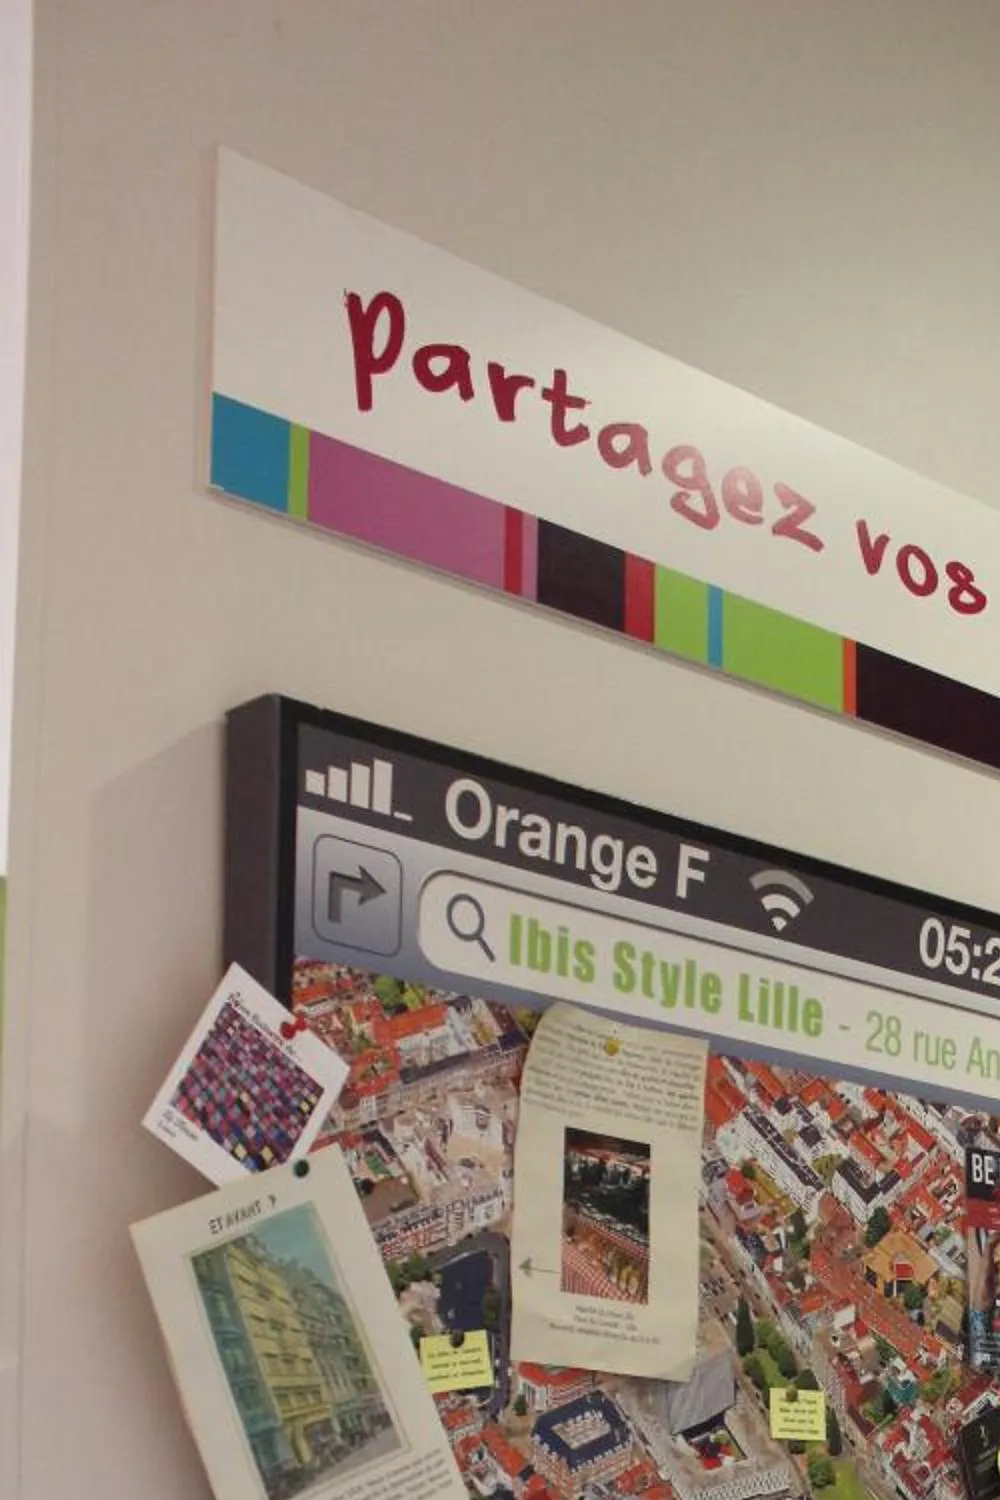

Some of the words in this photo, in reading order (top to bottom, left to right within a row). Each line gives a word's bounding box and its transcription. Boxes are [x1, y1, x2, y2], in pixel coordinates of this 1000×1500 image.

[344, 290, 825, 553] partagez
[856, 519, 987, 615] vos
[444, 778, 658, 892] Orange
[675, 843, 711, 900] F
[509, 914, 595, 983] Ibis
[612, 940, 723, 1014] Style
[737, 972, 824, 1038] Lille
[864, 1010, 901, 1057] 28
[913, 1028, 957, 1071] rue
[971, 1152, 994, 1186] BE
